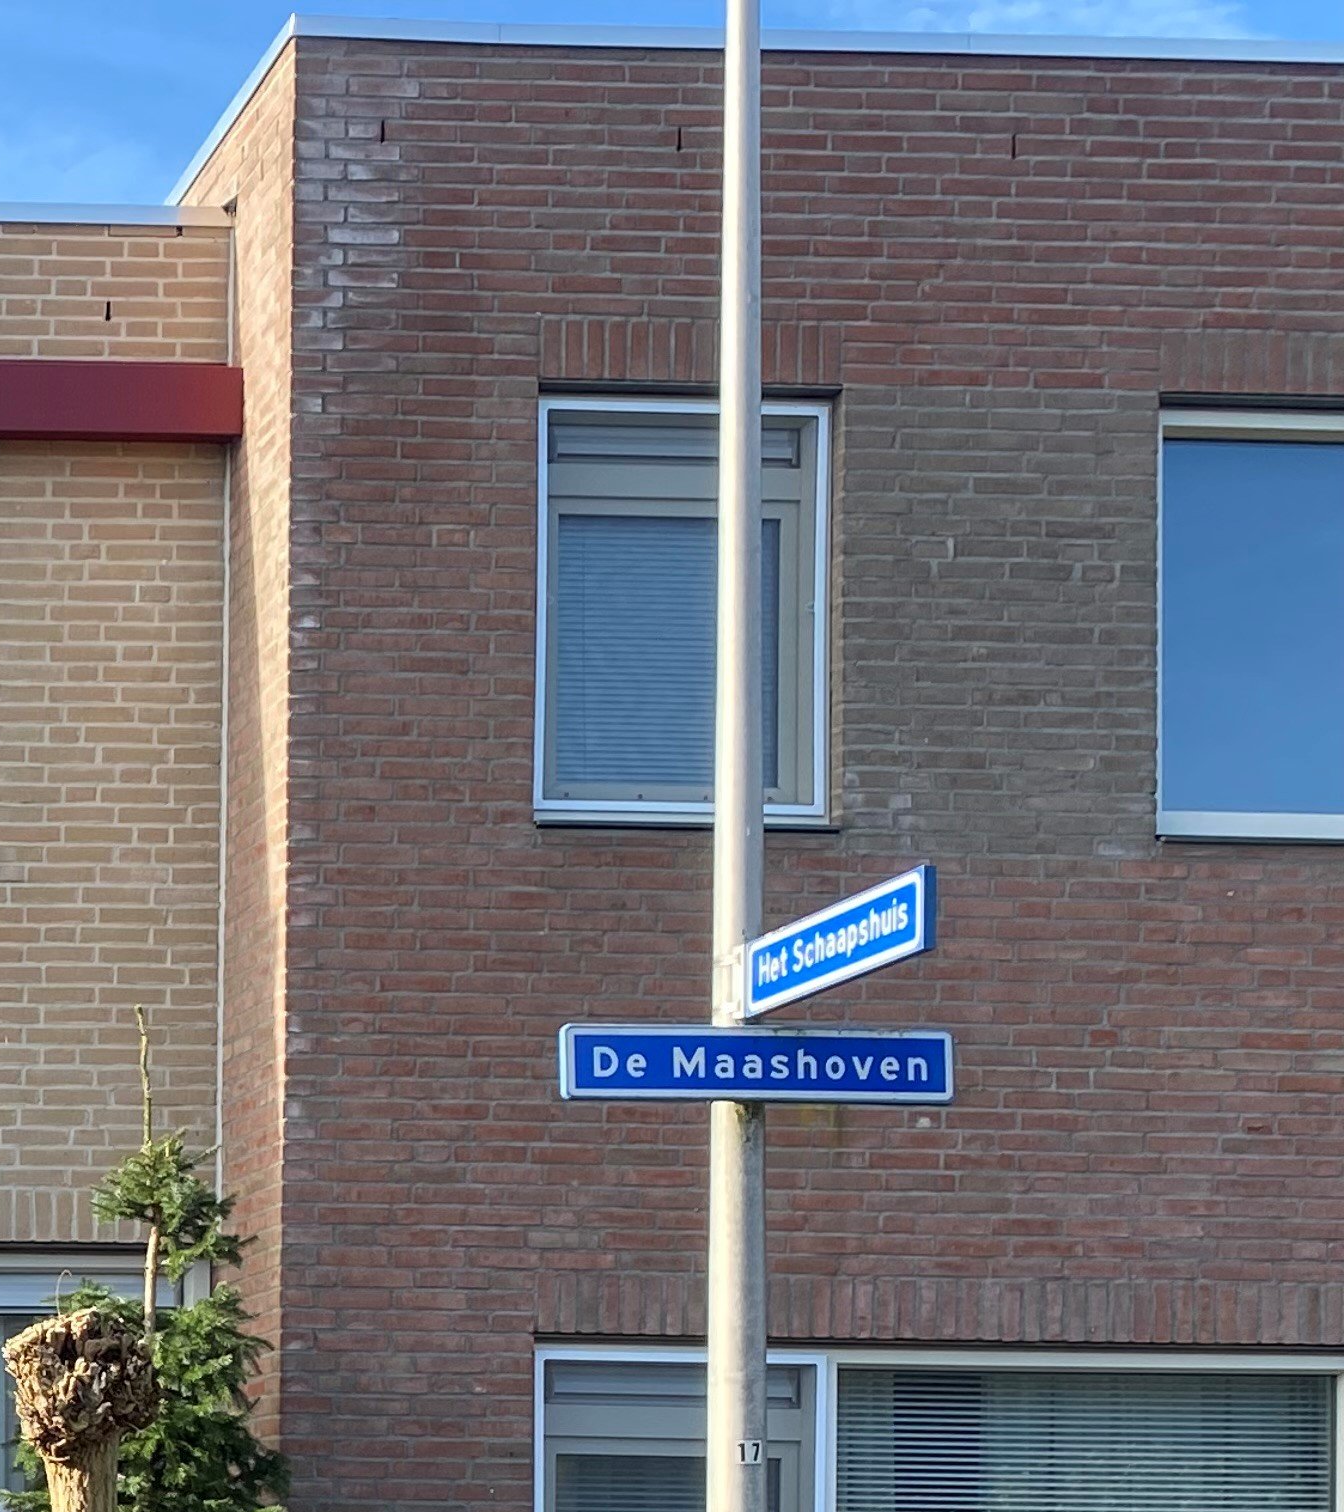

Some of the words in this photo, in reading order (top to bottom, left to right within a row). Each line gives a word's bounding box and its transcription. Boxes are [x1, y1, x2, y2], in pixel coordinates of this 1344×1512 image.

[758, 951, 788, 987] Het
[793, 898, 908, 971] Schaapshuis
[592, 1046, 647, 1078] De
[673, 1046, 929, 1081] Maashoven
[737, 1443, 760, 1462] 17
